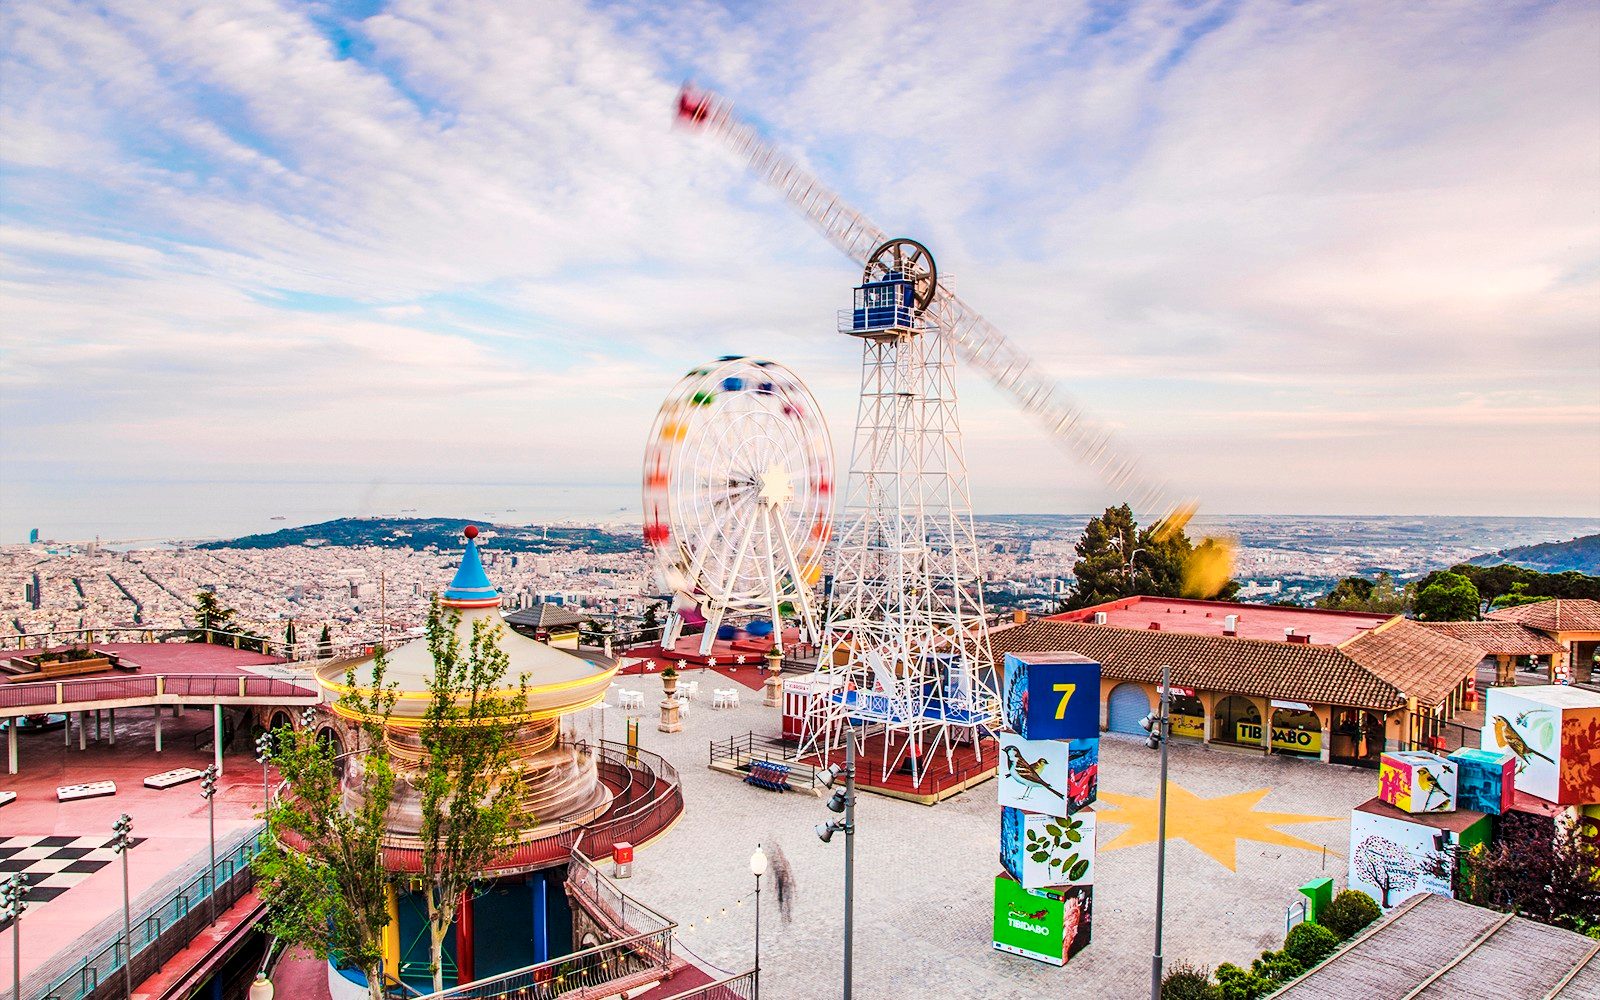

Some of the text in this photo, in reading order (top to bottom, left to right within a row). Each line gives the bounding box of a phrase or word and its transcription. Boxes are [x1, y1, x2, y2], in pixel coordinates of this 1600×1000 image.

[1053, 684, 1076, 719] 7
[1239, 725, 1312, 746] TIBDABO
[1008, 917, 1050, 936] TIBIDABO
